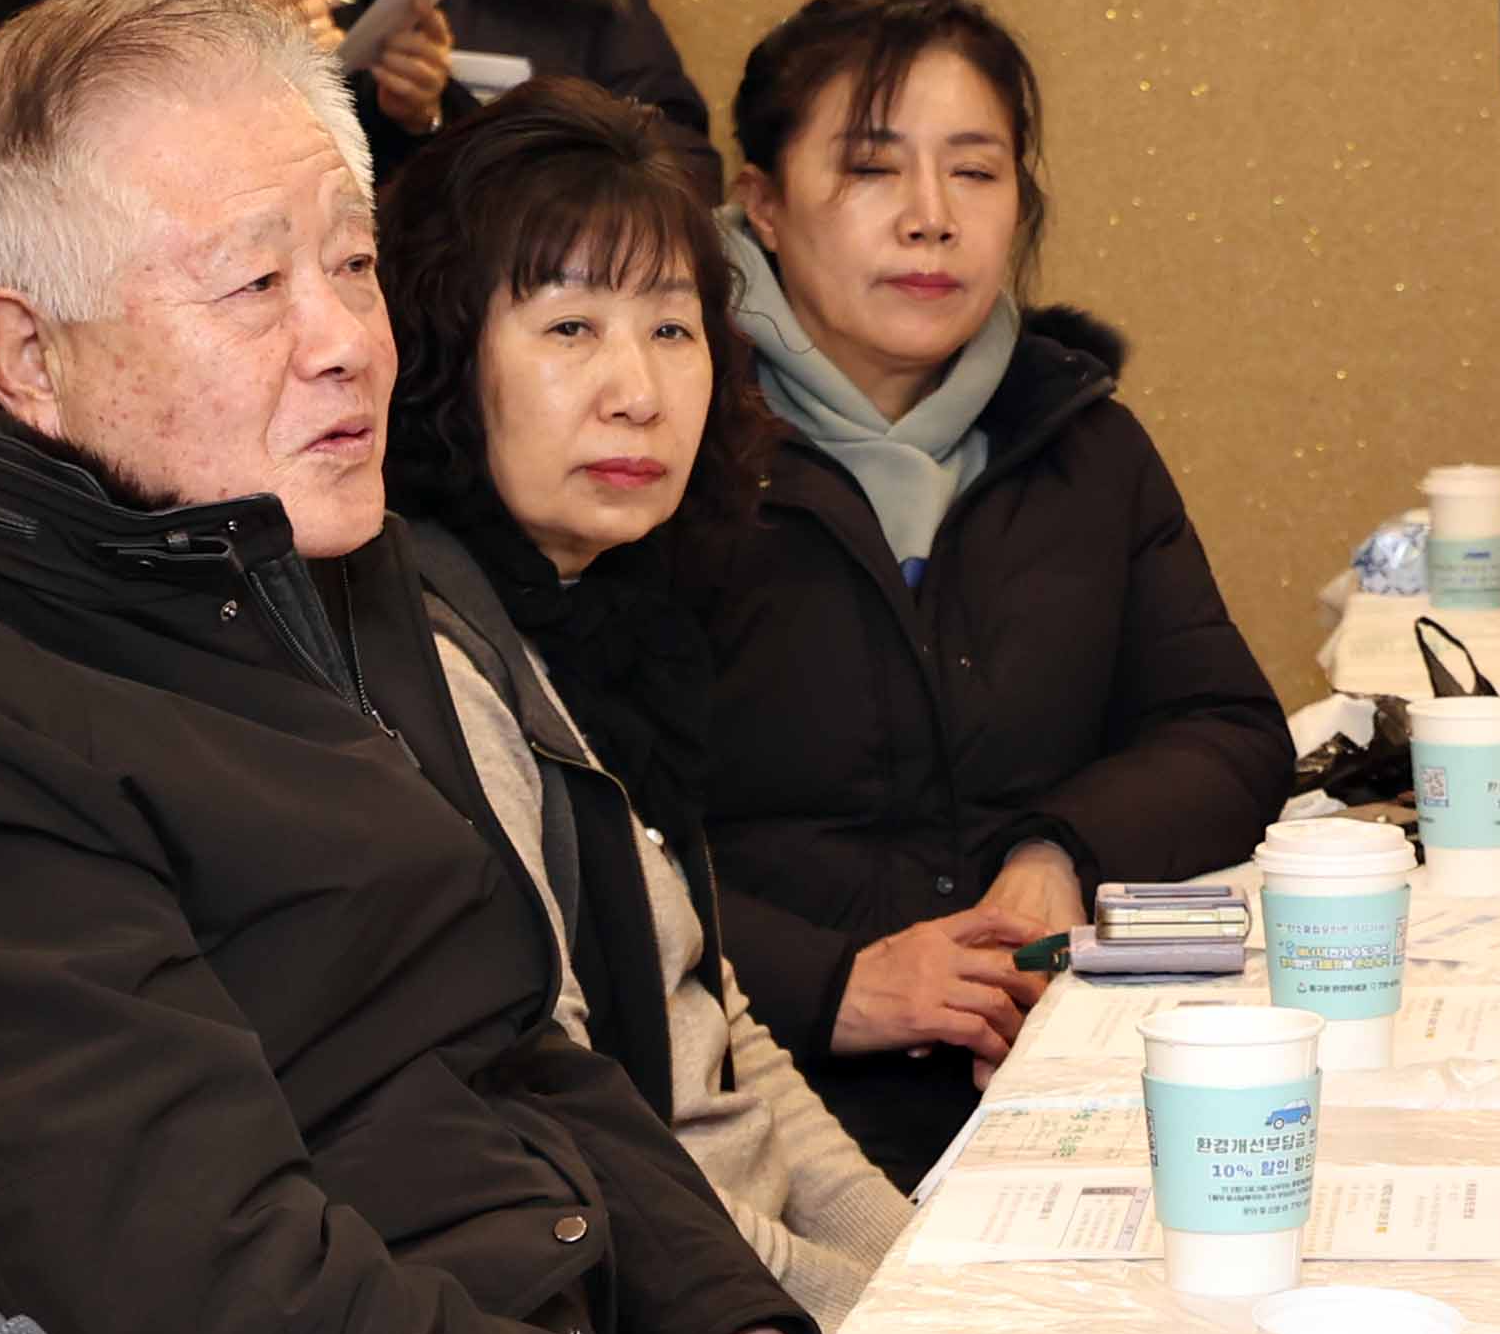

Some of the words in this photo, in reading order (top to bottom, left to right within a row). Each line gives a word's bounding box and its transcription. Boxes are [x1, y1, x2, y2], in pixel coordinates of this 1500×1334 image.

[1196, 1131, 1307, 1155] 환경개선부담금
[1211, 1163, 1254, 1179] 10%
[1260, 1158, 1290, 1177] 할인
